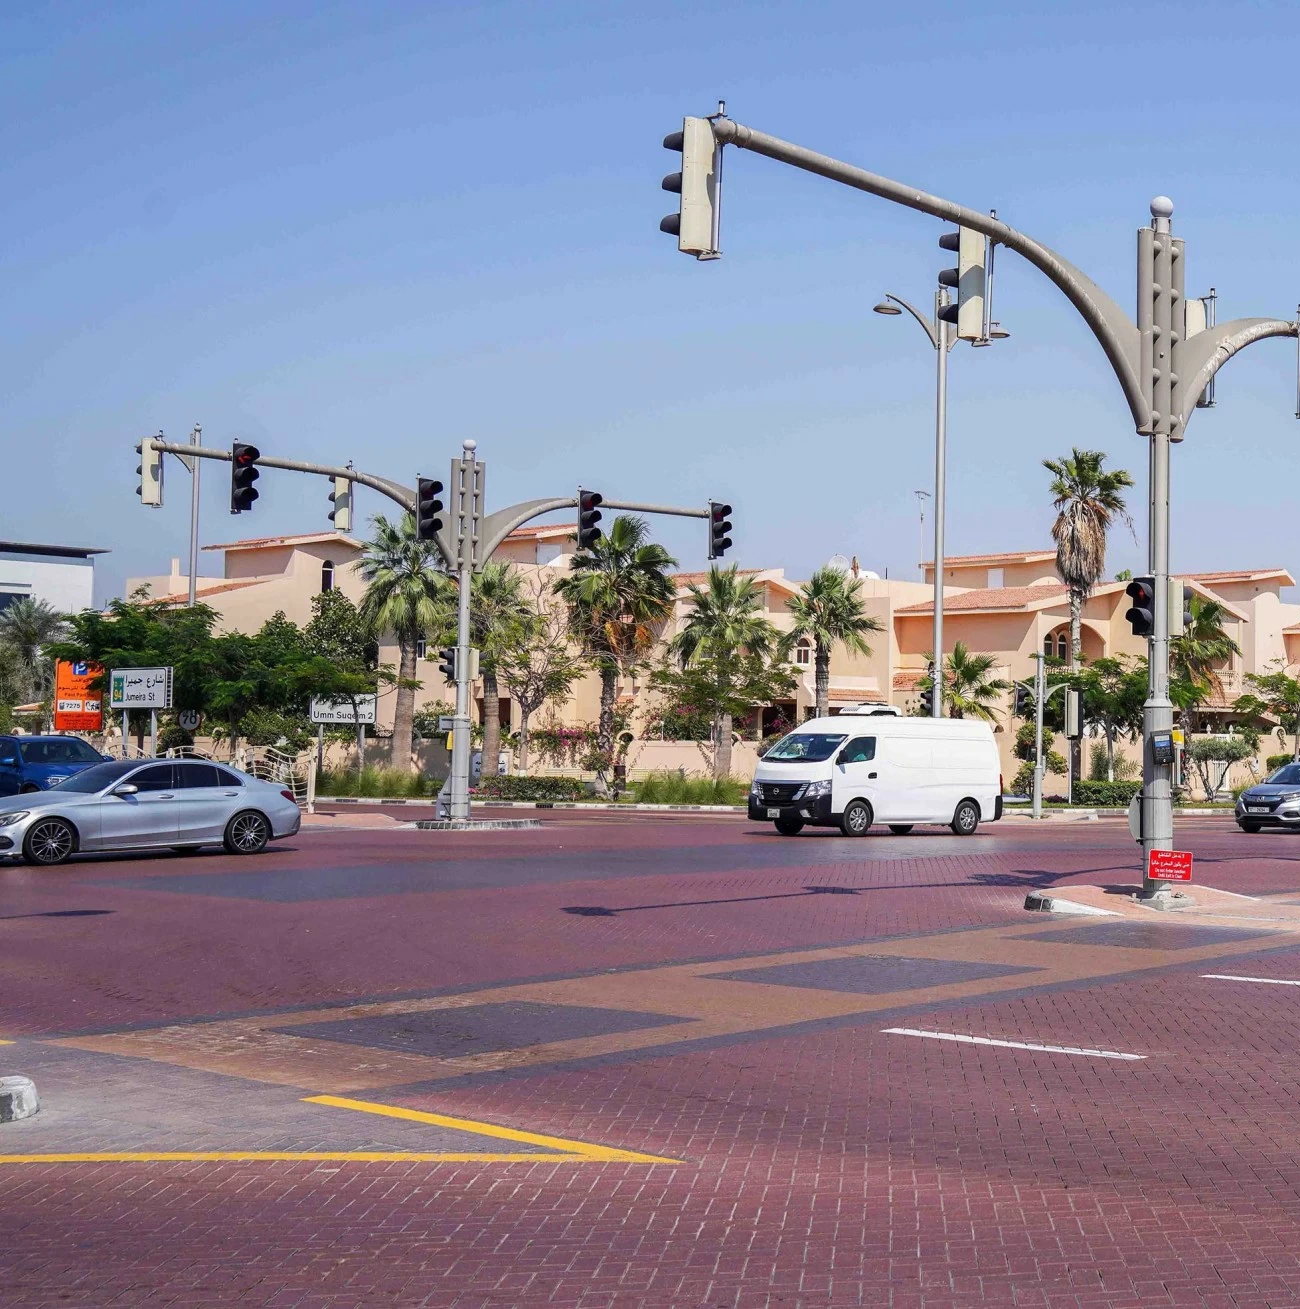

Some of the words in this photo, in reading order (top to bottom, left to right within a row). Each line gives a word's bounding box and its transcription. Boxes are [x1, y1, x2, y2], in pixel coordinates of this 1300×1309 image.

[125, 674, 143, 688] جميرا
[146, 674, 164, 688] شارع
[125, 692, 146, 701] Jumeira
[148, 692, 155, 701] St
[182, 714, 197, 725] 70
[313, 711, 334, 719] Umm
[336, 711, 366, 720] Suqem
[367, 711, 374, 720] 2
